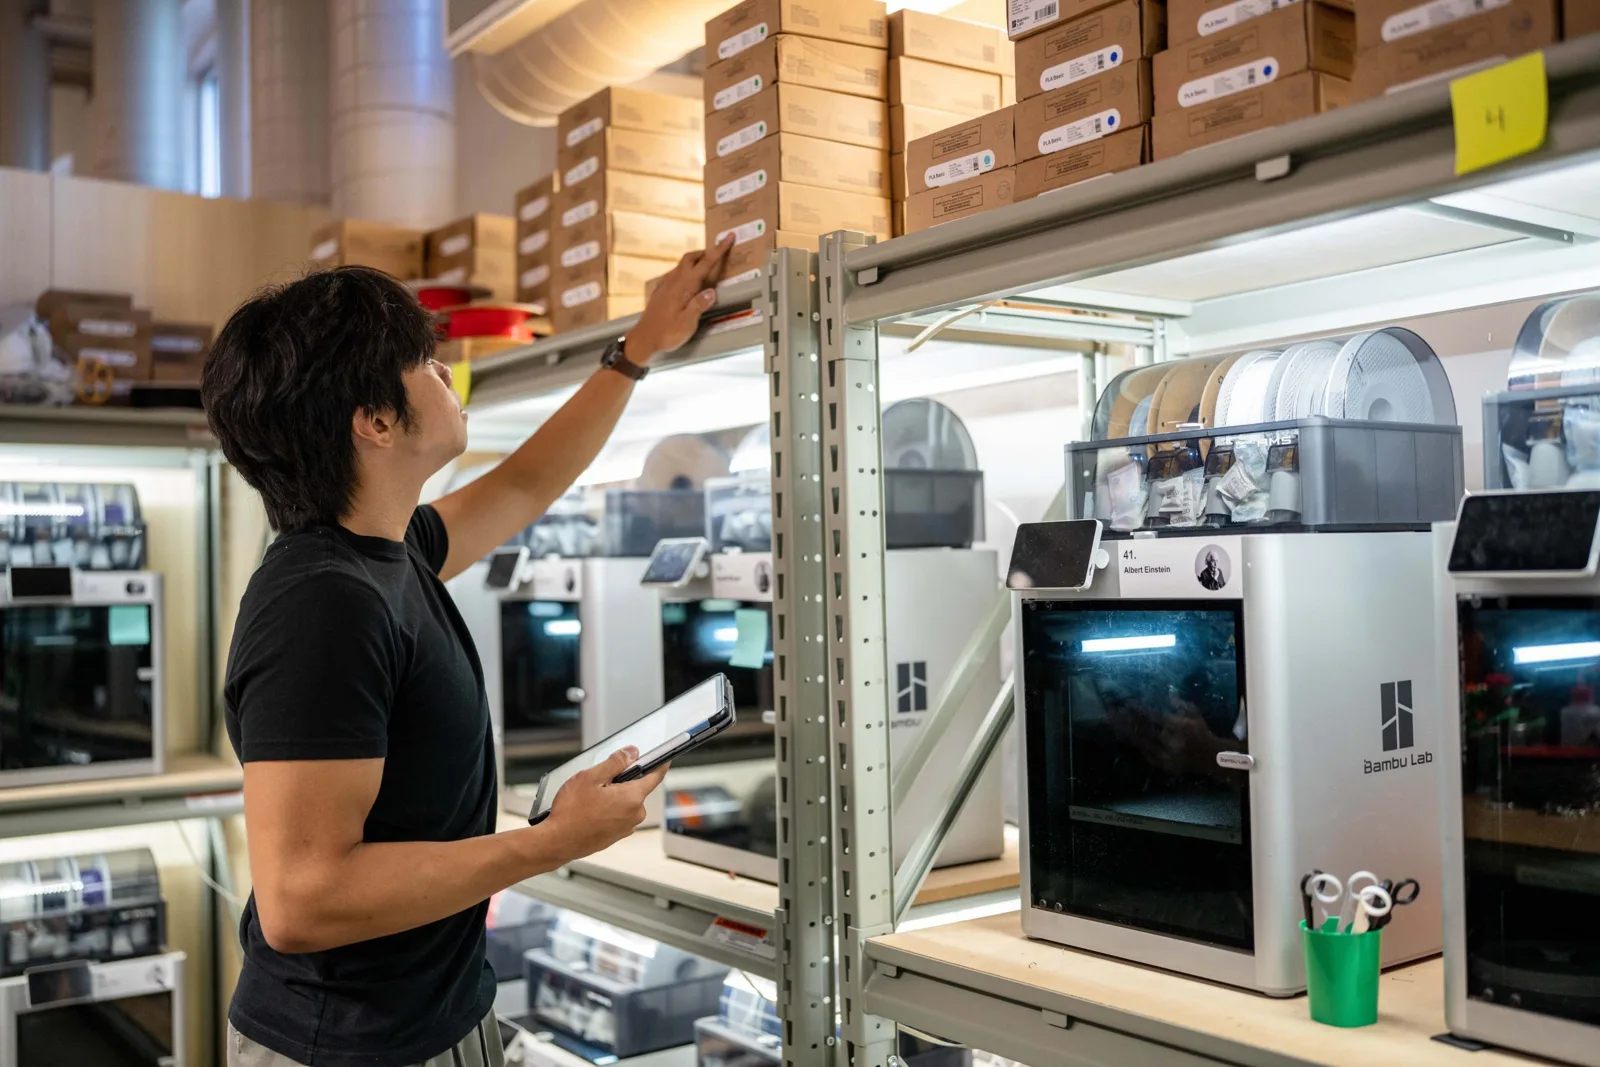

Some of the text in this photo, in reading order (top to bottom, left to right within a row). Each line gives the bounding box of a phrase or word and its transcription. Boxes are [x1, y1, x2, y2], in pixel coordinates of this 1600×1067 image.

[1054, 73, 1064, 81] Basic
[1052, 136, 1062, 144] Basic
[1123, 550, 1136, 560] 41.
[1145, 565, 1171, 573] Einstein
[1364, 751, 1433, 774] Bambu Lab
